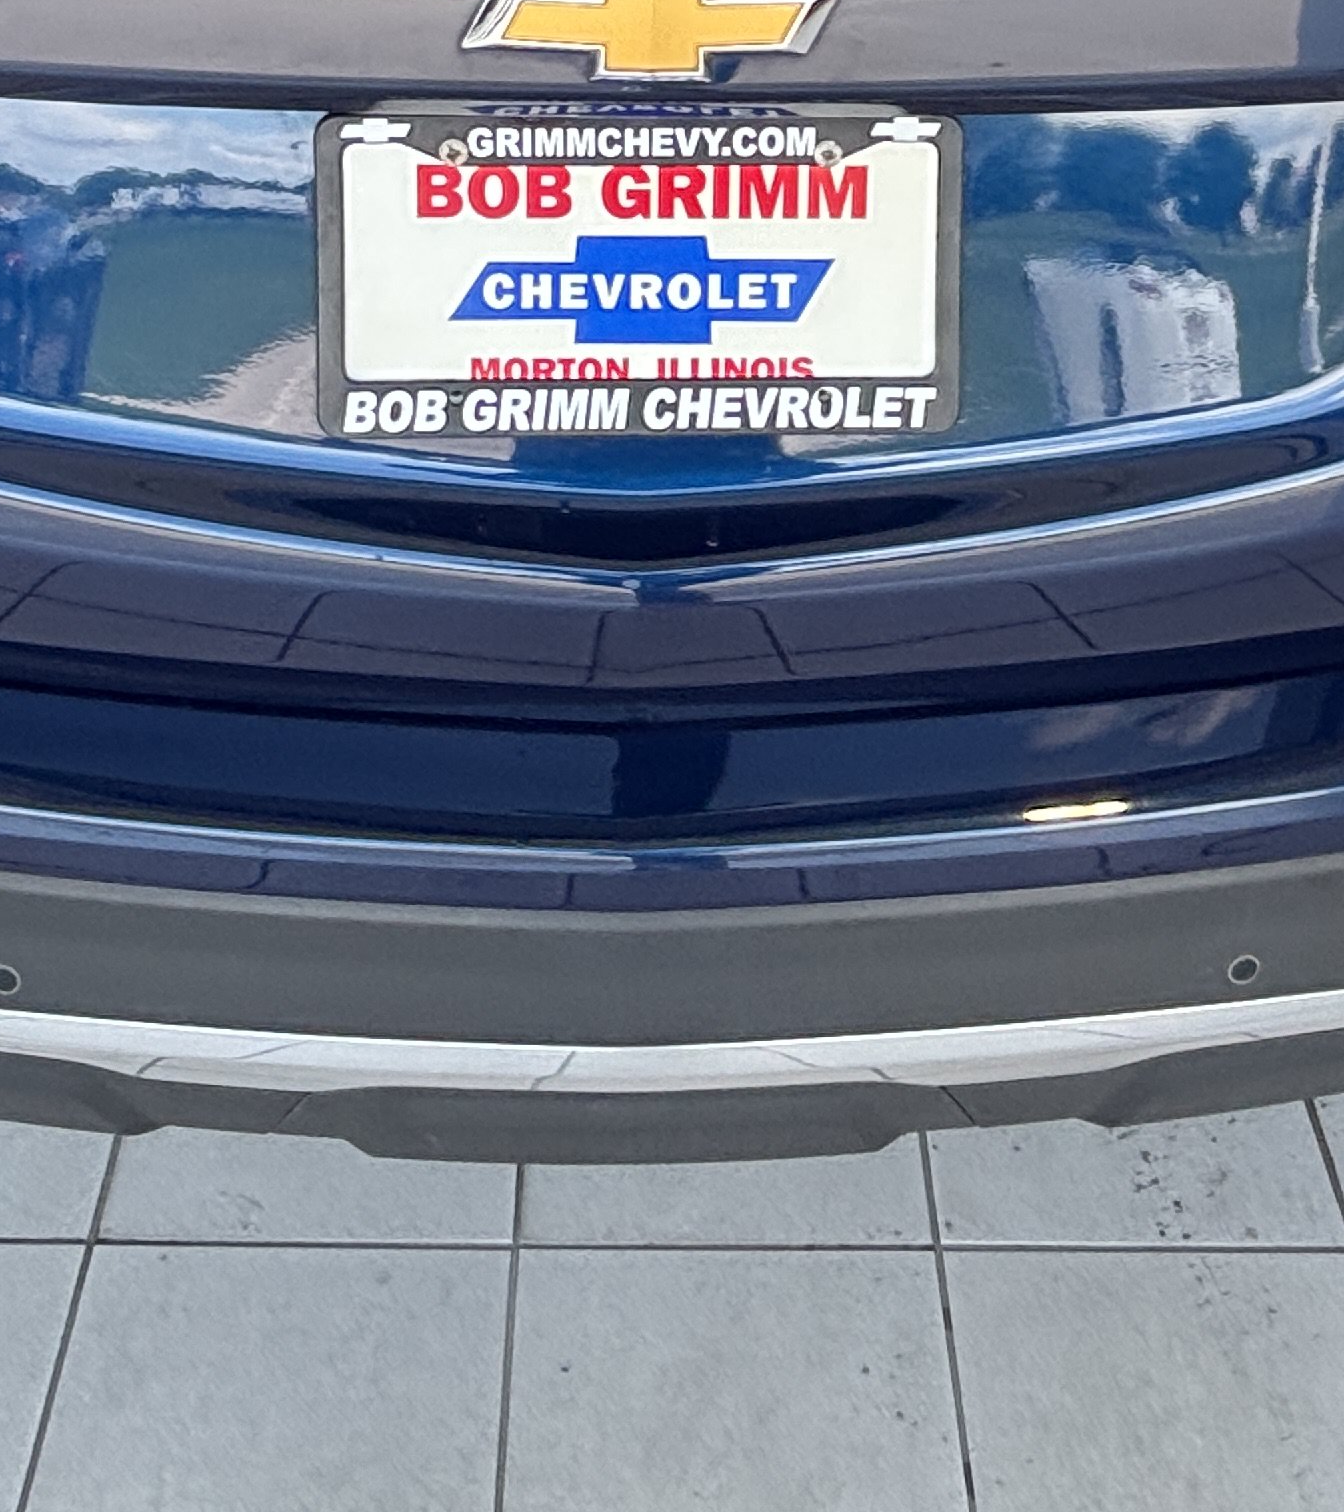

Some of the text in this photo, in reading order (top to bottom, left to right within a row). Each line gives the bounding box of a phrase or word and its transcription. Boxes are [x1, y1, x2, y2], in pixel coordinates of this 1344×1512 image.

[467, 126, 817, 158] GRIMMCHEVY.COM
[416, 165, 869, 219] BOB GRIMM
[482, 272, 798, 311] CHEVROLET
[471, 357, 630, 381] MORTON
[343, 386, 937, 434] BOB GRIMM CHEVROLET
